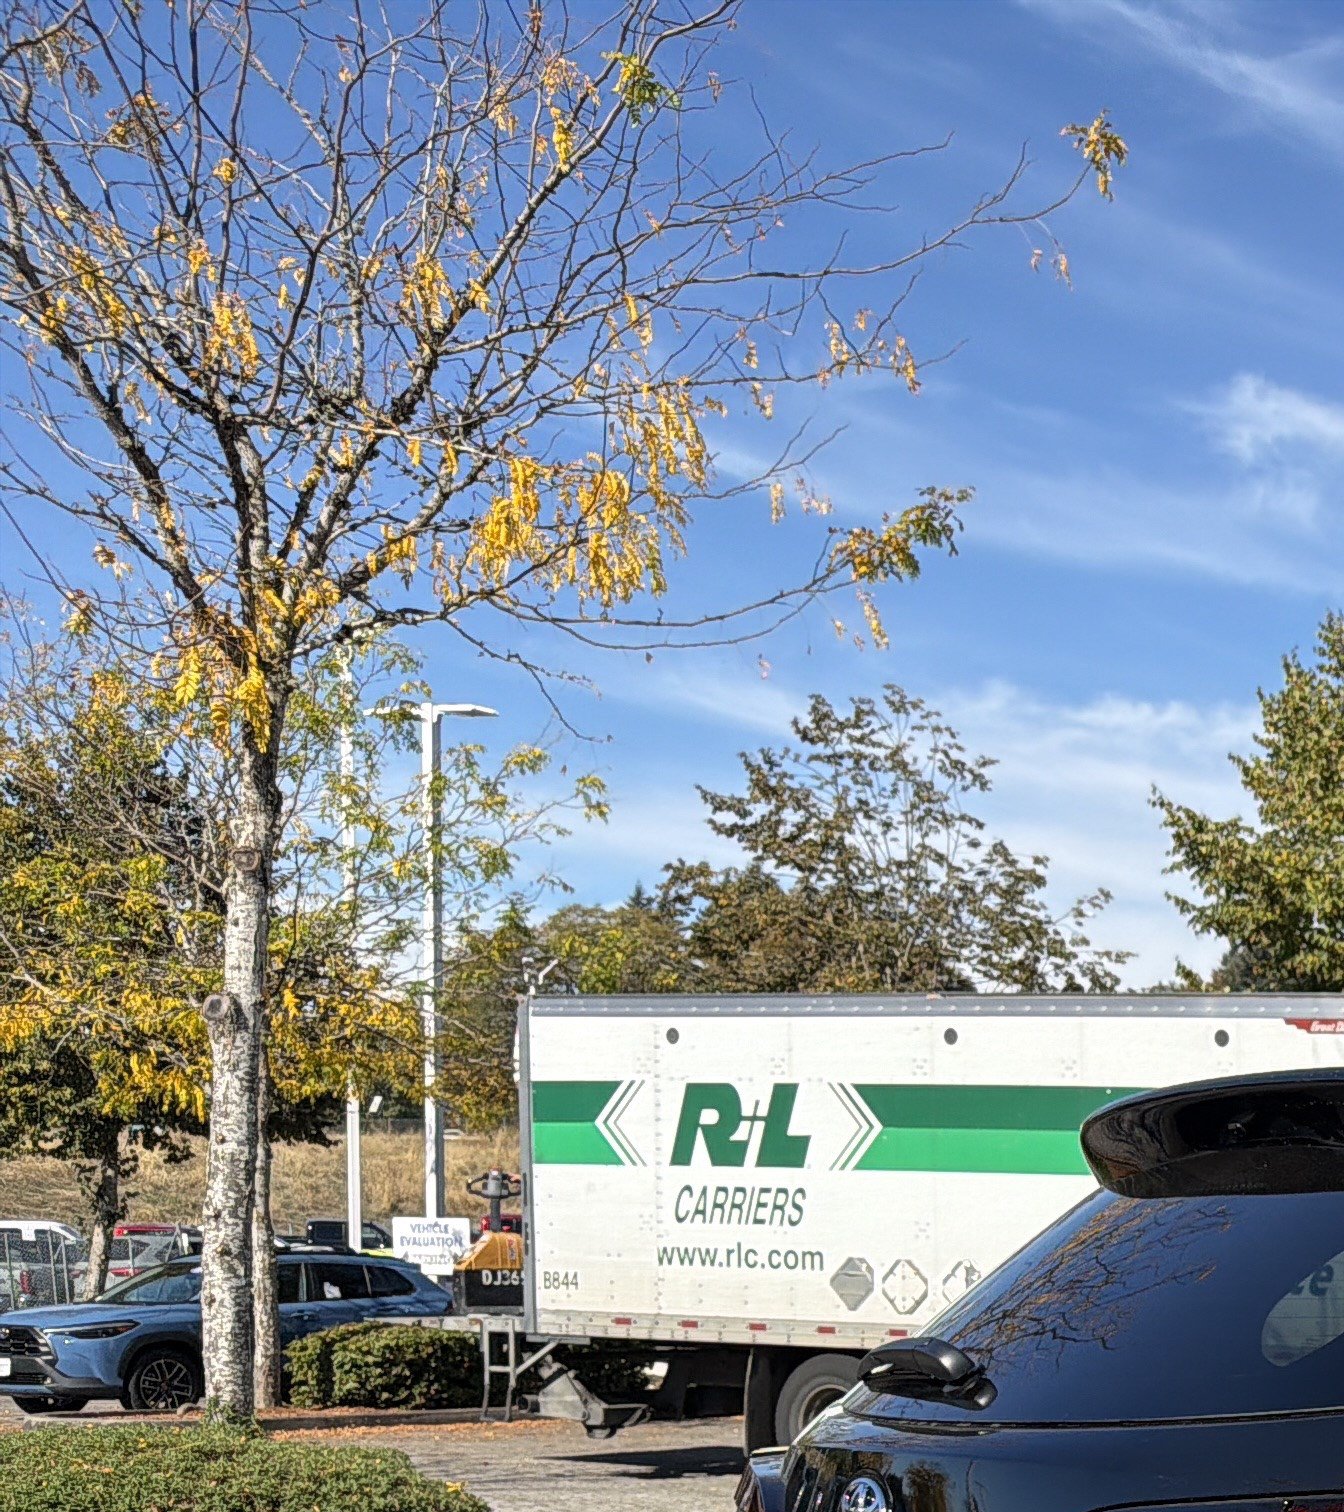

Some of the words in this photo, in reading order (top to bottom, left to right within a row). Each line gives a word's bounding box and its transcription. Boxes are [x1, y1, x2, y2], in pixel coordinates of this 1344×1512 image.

[673, 1184, 807, 1227] CARRIERS
[410, 1222, 450, 1235] VEHICLE
[399, 1235, 464, 1248] EVALUATION
[656, 1241, 826, 1272] www.rlc.com
[542, 1271, 580, 1291] B844
